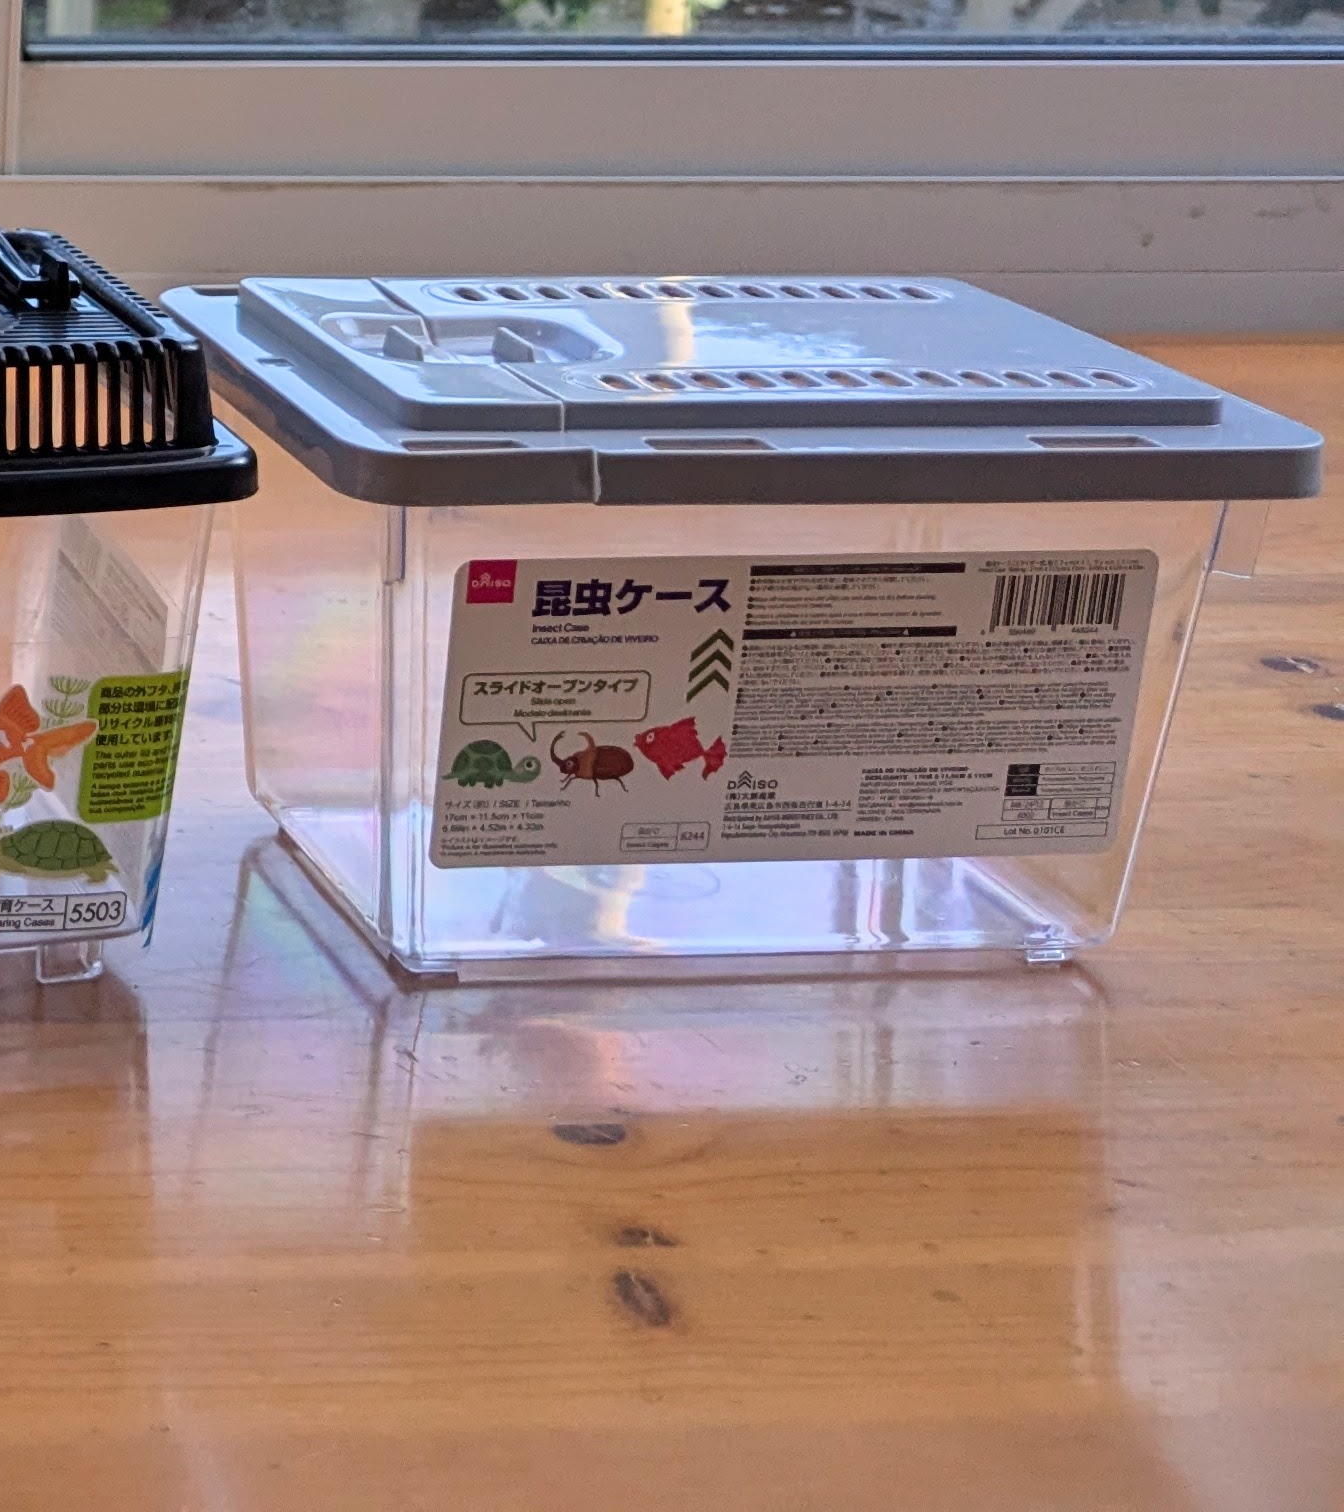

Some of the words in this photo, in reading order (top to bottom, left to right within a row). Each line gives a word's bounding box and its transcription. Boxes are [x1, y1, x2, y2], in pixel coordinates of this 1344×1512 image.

[531, 578, 732, 618] 昆虫ケース
[473, 677, 640, 696] スライドオープンタイプ
[69, 899, 122, 924] 5503
